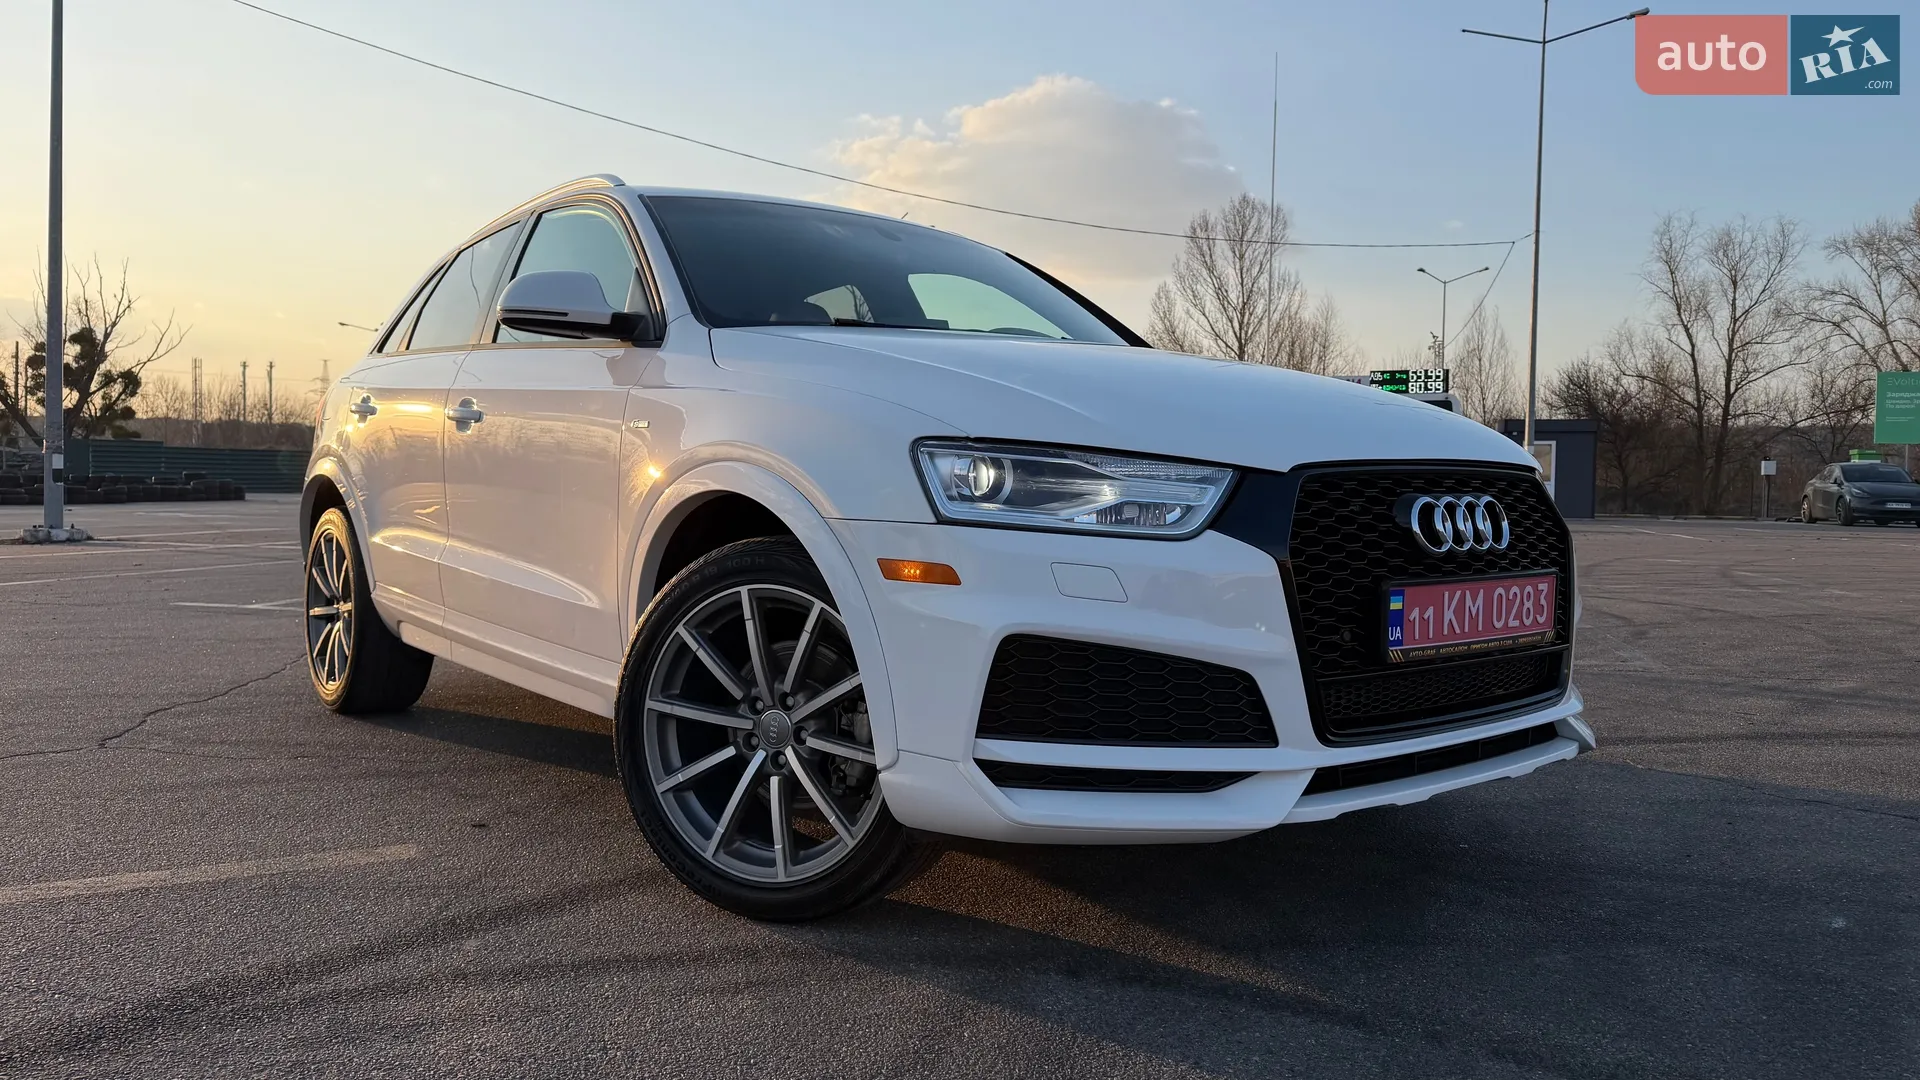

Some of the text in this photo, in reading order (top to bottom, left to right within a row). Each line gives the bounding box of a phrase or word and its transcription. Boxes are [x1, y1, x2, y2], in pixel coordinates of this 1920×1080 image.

[1408, 368, 1444, 382] 69.99
[1408, 381, 1444, 394] 80.99
[1408, 583, 1549, 640] 11 KM 0283
[1388, 626, 1402, 640] UA
